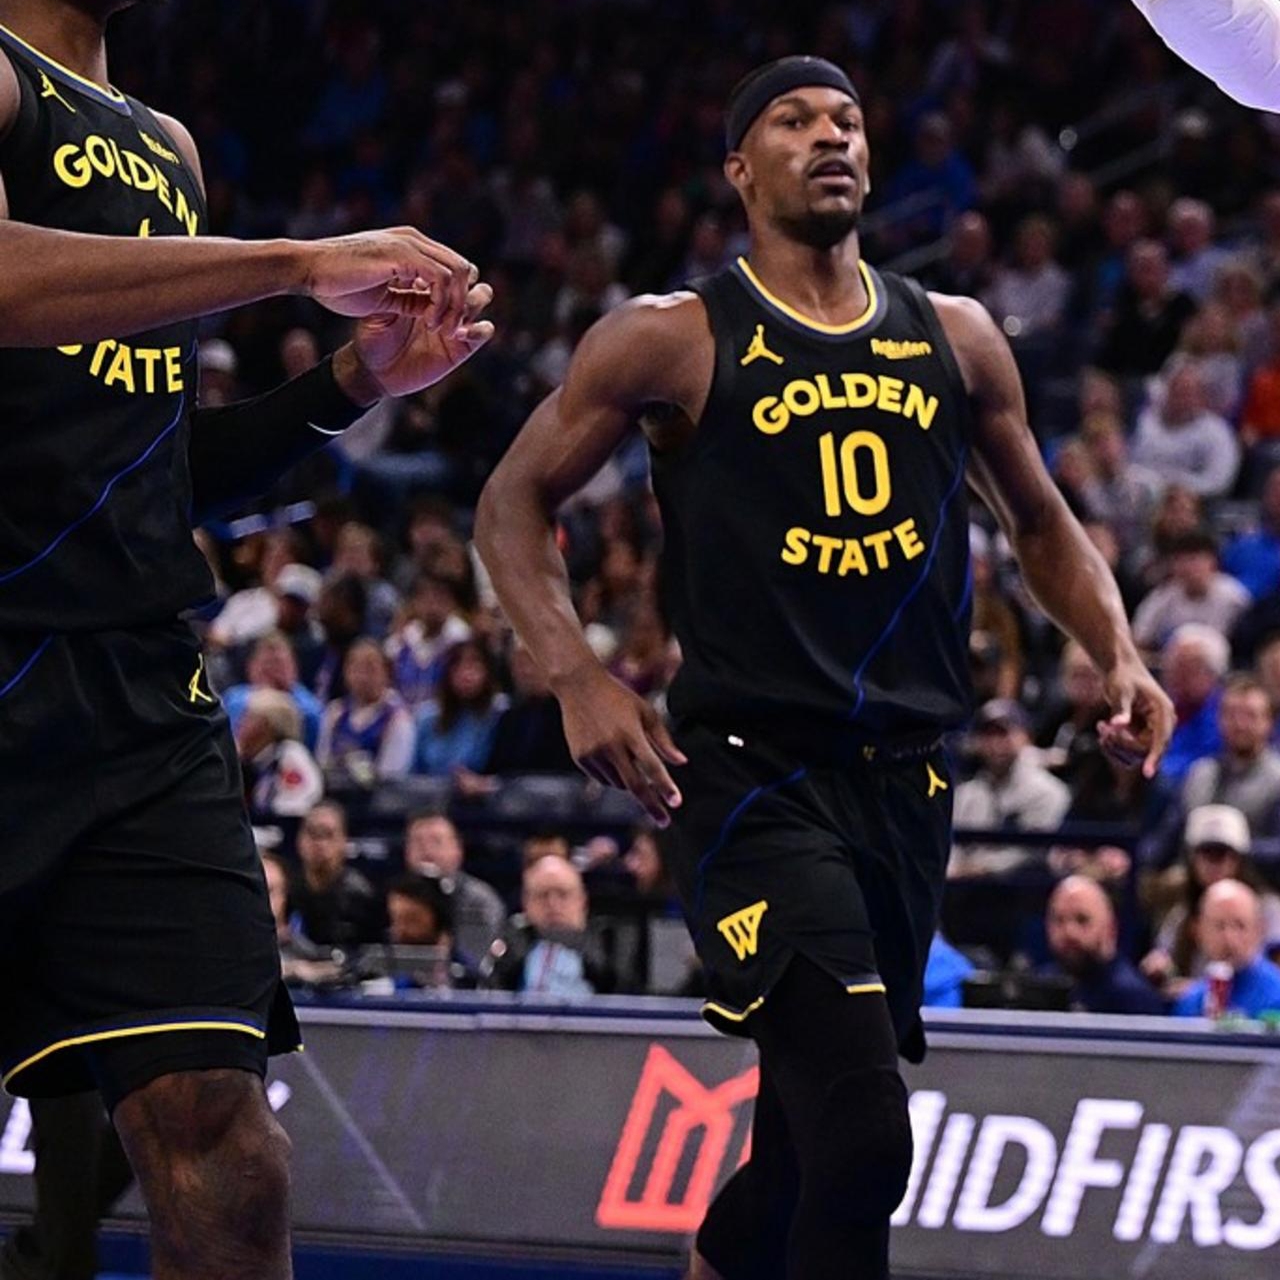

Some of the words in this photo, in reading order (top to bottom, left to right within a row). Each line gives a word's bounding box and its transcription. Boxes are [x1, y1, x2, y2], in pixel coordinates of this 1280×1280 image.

[53, 135, 198, 237] GOLDEN
[57, 338, 184, 393] TATE
[752, 373, 939, 435] GOLDEN
[819, 430, 892, 517] 10
[780, 518, 926, 577] STATE
